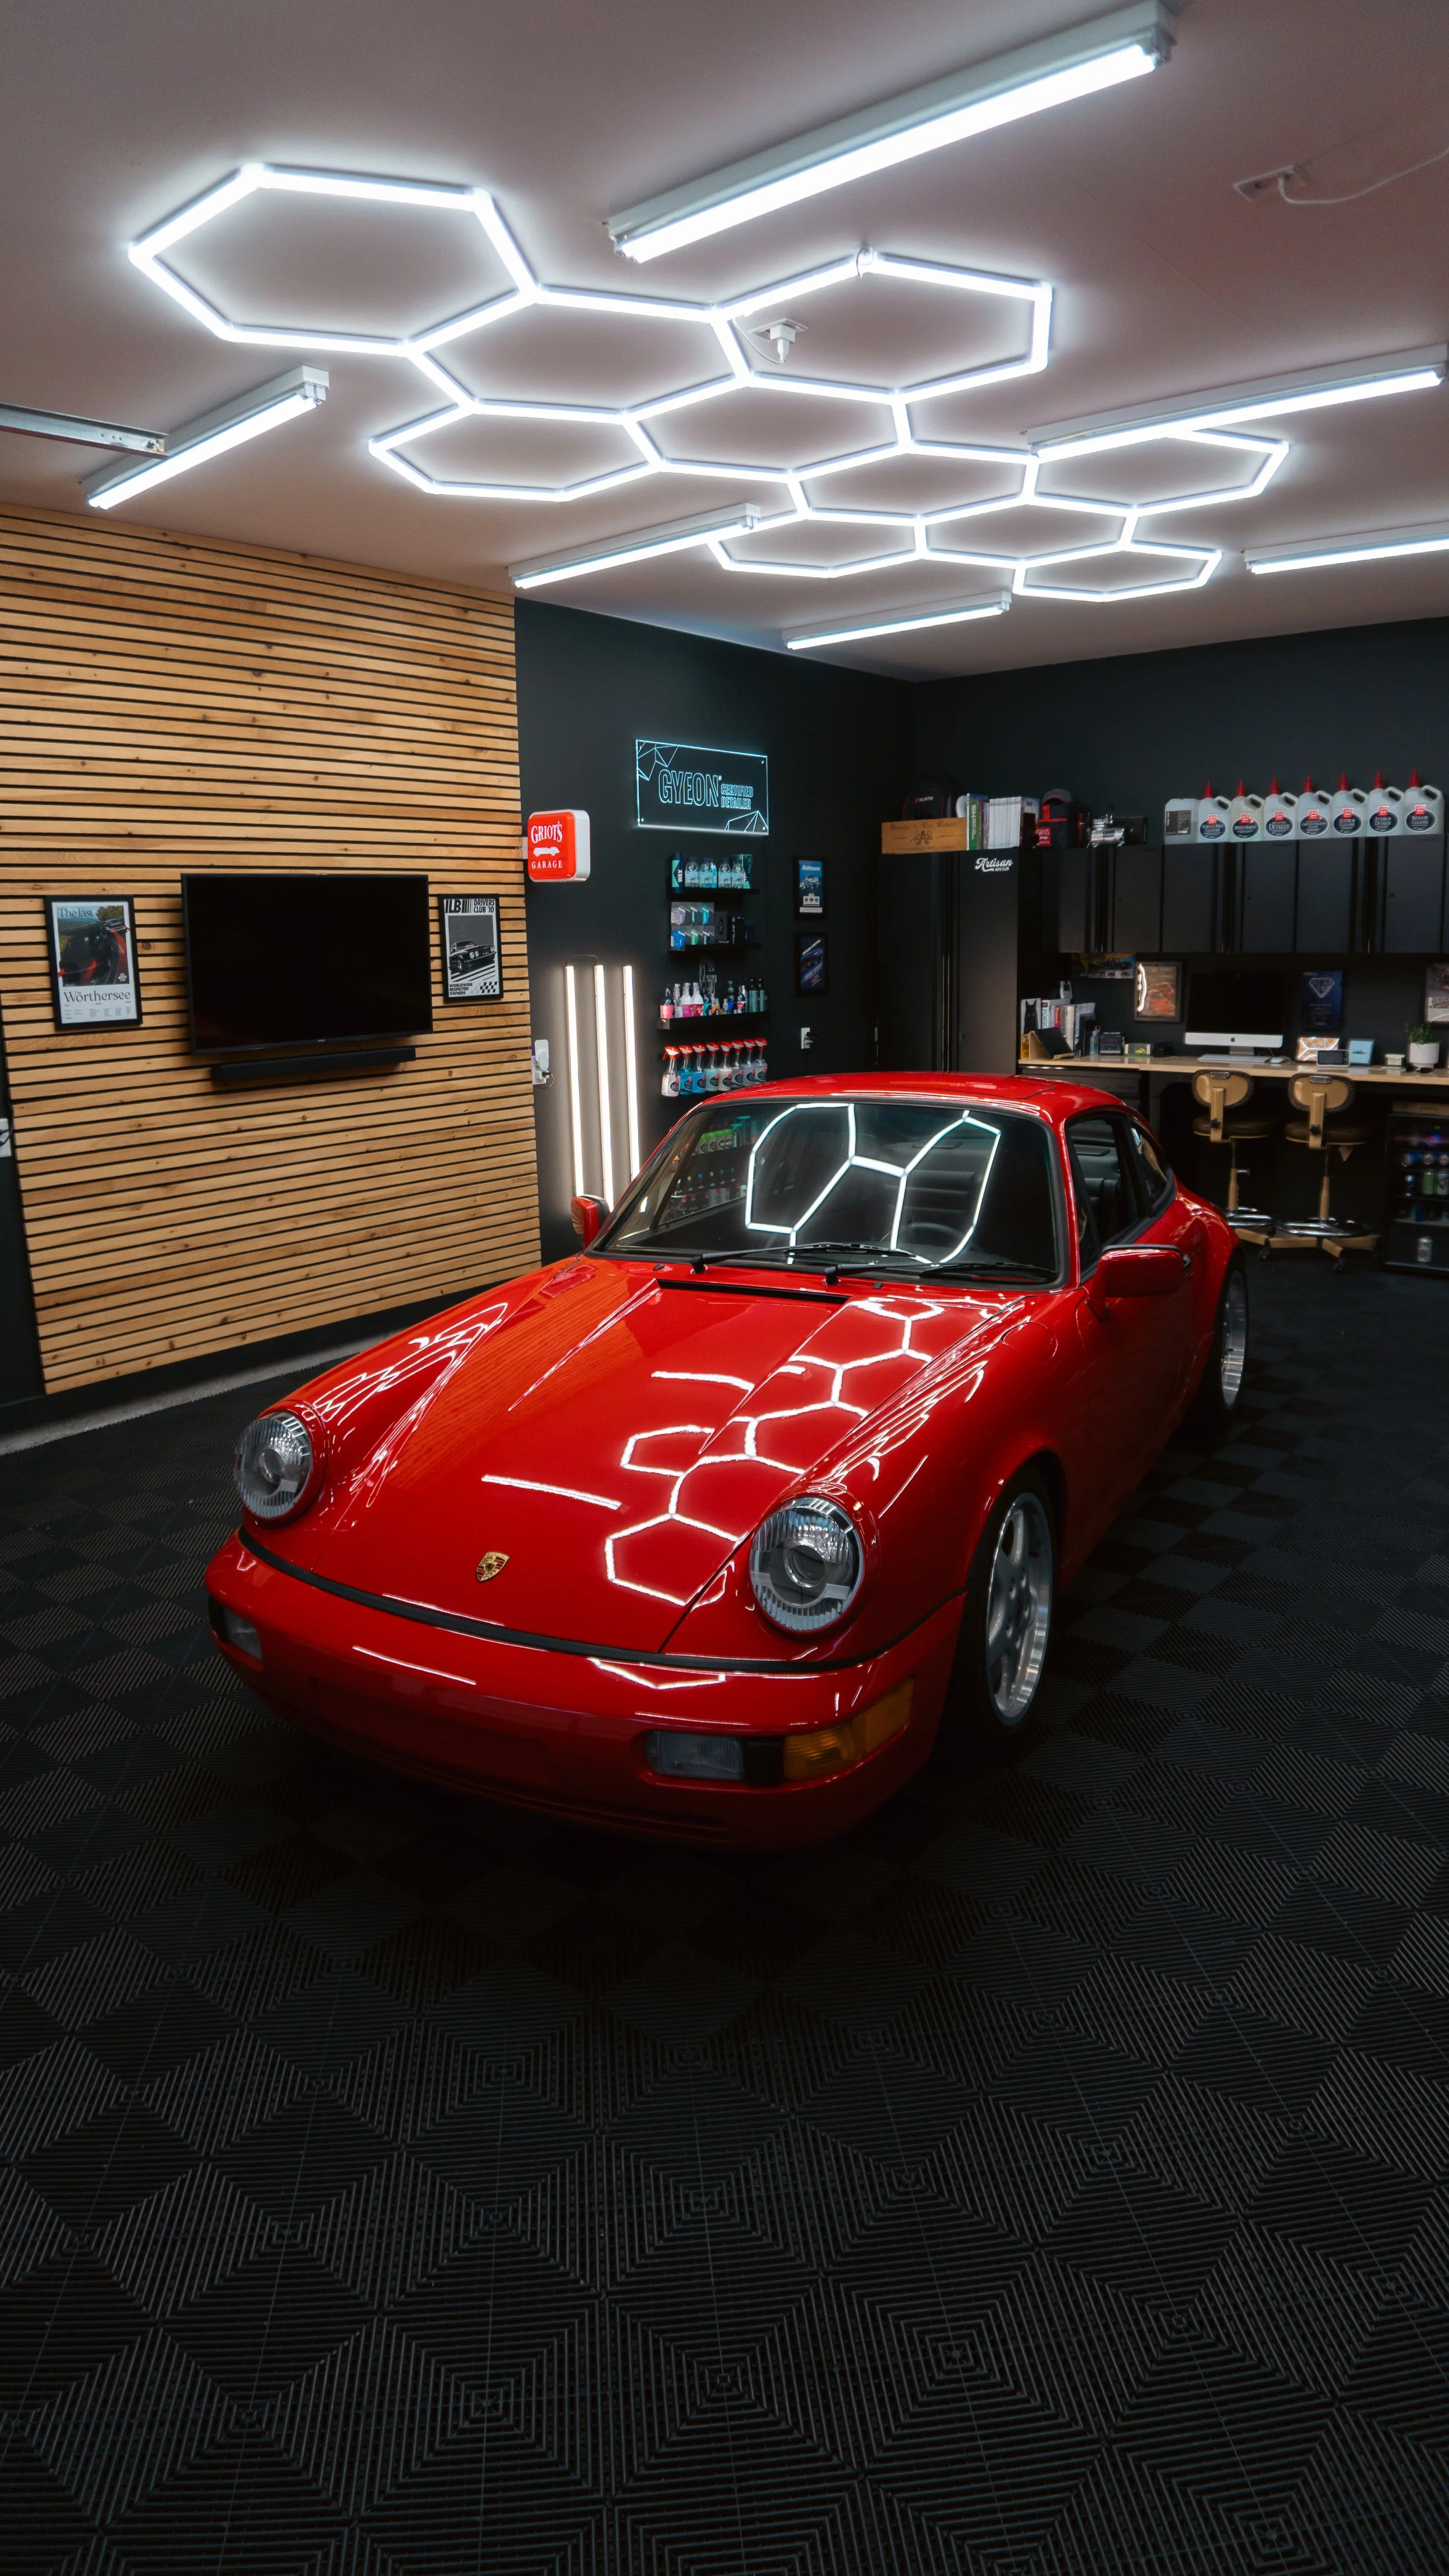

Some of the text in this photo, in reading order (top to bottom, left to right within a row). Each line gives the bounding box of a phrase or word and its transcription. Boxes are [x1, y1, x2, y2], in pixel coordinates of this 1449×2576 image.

[658, 769, 719, 806] GYEON
[721, 784, 753, 798] CERTIFIED
[721, 796, 752, 809] DETAILER
[531, 821, 562, 844] GRIOT'S
[531, 860, 563, 869] GARAGE
[975, 858, 1013, 872] Artisan
[59, 907, 93, 918] The last
[64, 990, 131, 1002] Wörthersee
